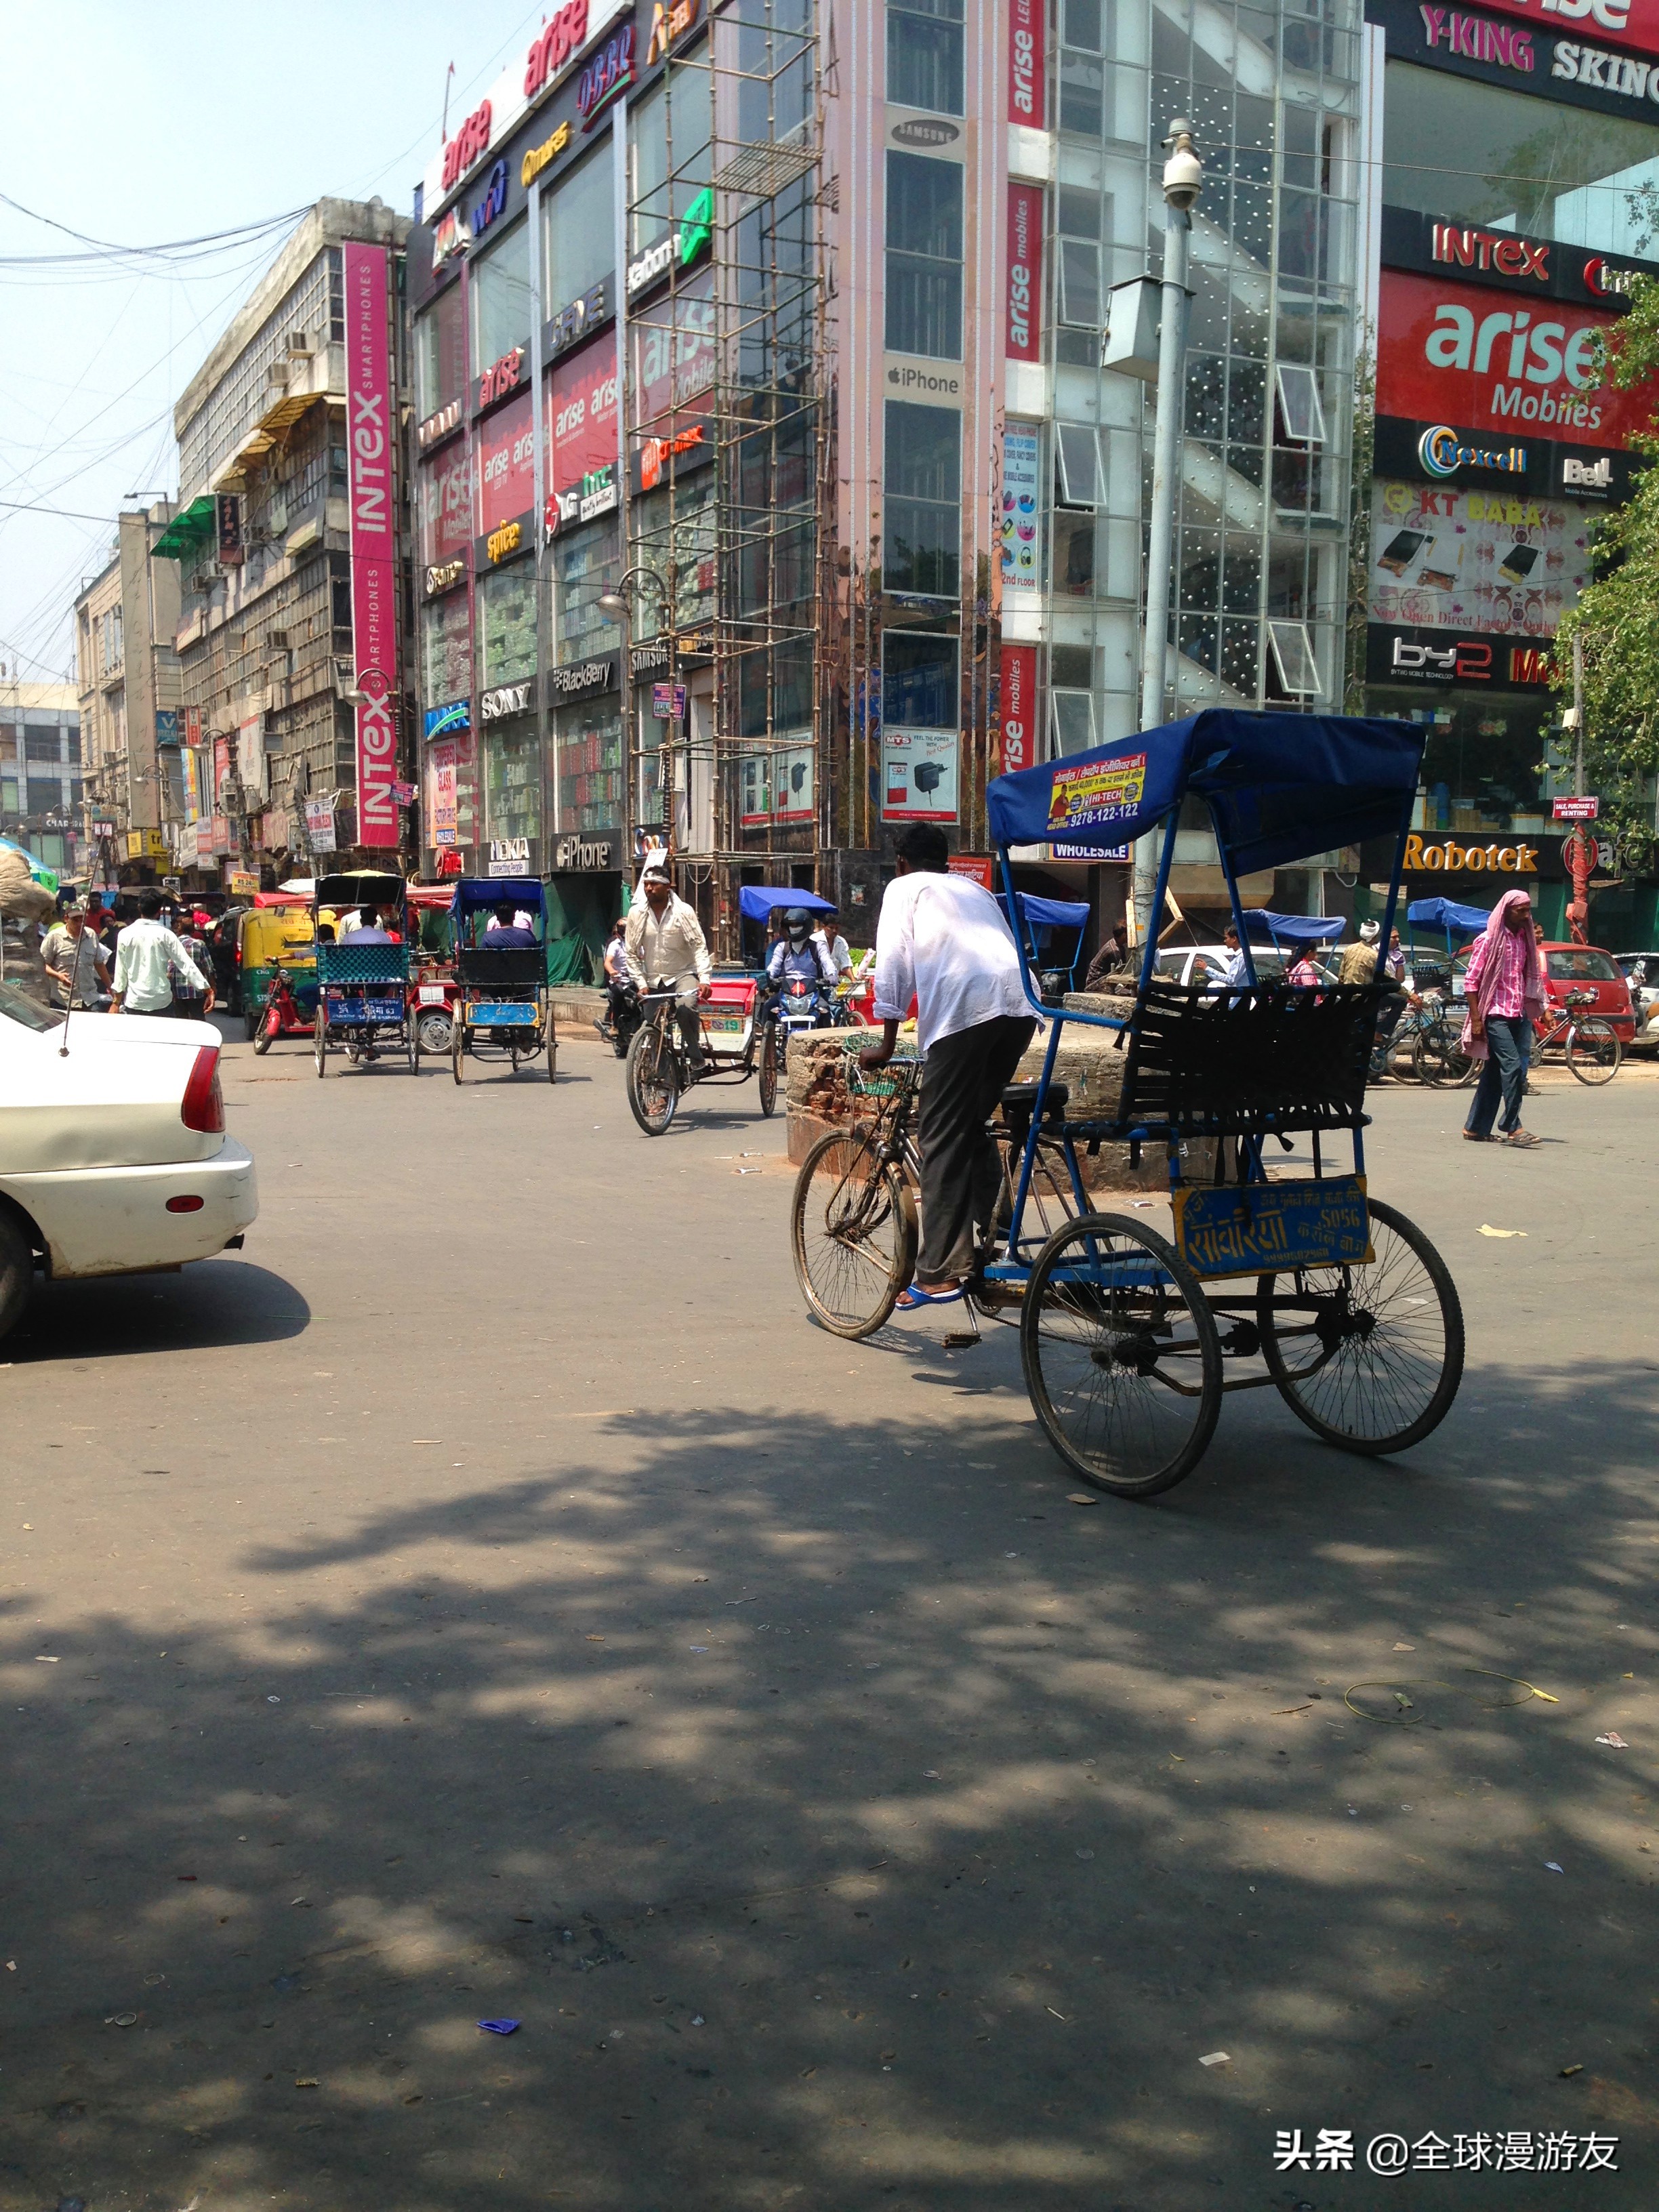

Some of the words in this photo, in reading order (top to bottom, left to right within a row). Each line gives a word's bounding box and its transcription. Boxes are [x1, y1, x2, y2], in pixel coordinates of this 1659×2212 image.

[1419, 4, 1534, 72] Y-KING
[1013, 29, 1033, 114] arise
[1017, 199, 1028, 260] mobiles
[1010, 264, 1030, 348] arise
[361, 264, 373, 390] SMARTPHONES
[1425, 304, 1605, 390] arise
[479, 347, 522, 408] arise
[901, 367, 958, 394] iPhone
[556, 398, 585, 438] arise
[1491, 384, 1601, 429] Mobiles
[485, 448, 508, 483] arise
[1437, 439, 1528, 473] Nexcell
[554, 492, 578, 521] LG
[1420, 490, 1458, 516] KT
[1468, 496, 1541, 528] BABA
[487, 519, 520, 564] spice
[1002, 574, 1016, 587] 2nd
[1017, 577, 1036, 587] FLOOR
[1401, 608, 1434, 624] Open
[1438, 611, 1473, 626] Direct
[563, 661, 611, 692] BlackBerry
[1009, 659, 1021, 715] mobiles
[1409, 670, 1425, 678] MOBILE
[482, 682, 531, 720] SONY
[886, 736, 910, 744] MTS
[1092, 790, 1122, 803] HI-TECH
[1071, 803, 1138, 827] 9278-122-122
[491, 837, 530, 861] NOKIA
[567, 836, 609, 869] iPhone
[1057, 844, 1126, 858] WHOLESALE
[1402, 834, 1540, 873] Robotek
[491, 863, 510, 876] Connecting
[510, 861, 523, 874] People
